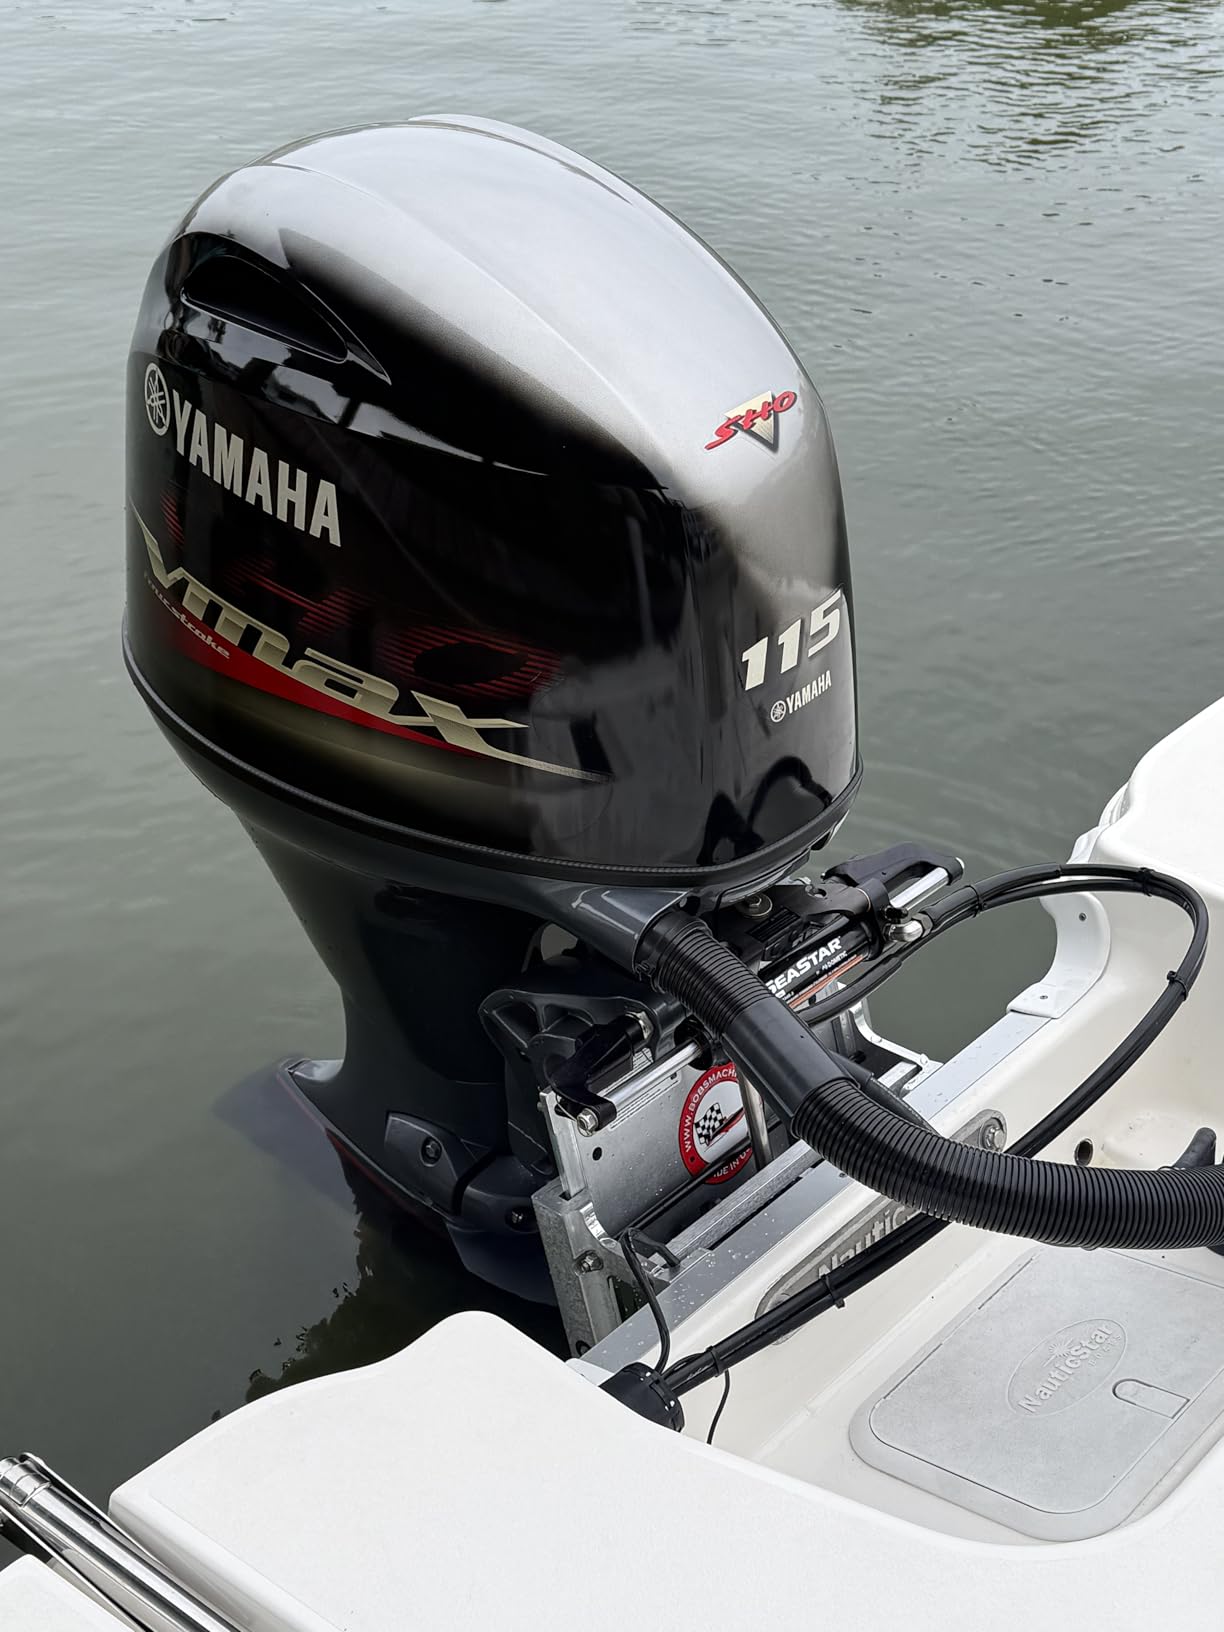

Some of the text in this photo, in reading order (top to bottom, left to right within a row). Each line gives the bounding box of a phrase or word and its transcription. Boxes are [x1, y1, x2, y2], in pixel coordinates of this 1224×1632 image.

[704, 390, 798, 450] SHO
[171, 387, 342, 548] YAMAHA
[741, 587, 842, 692] 115
[785, 669, 833, 715] YAMAHA
[1018, 1324, 1113, 1413] NauticStar
